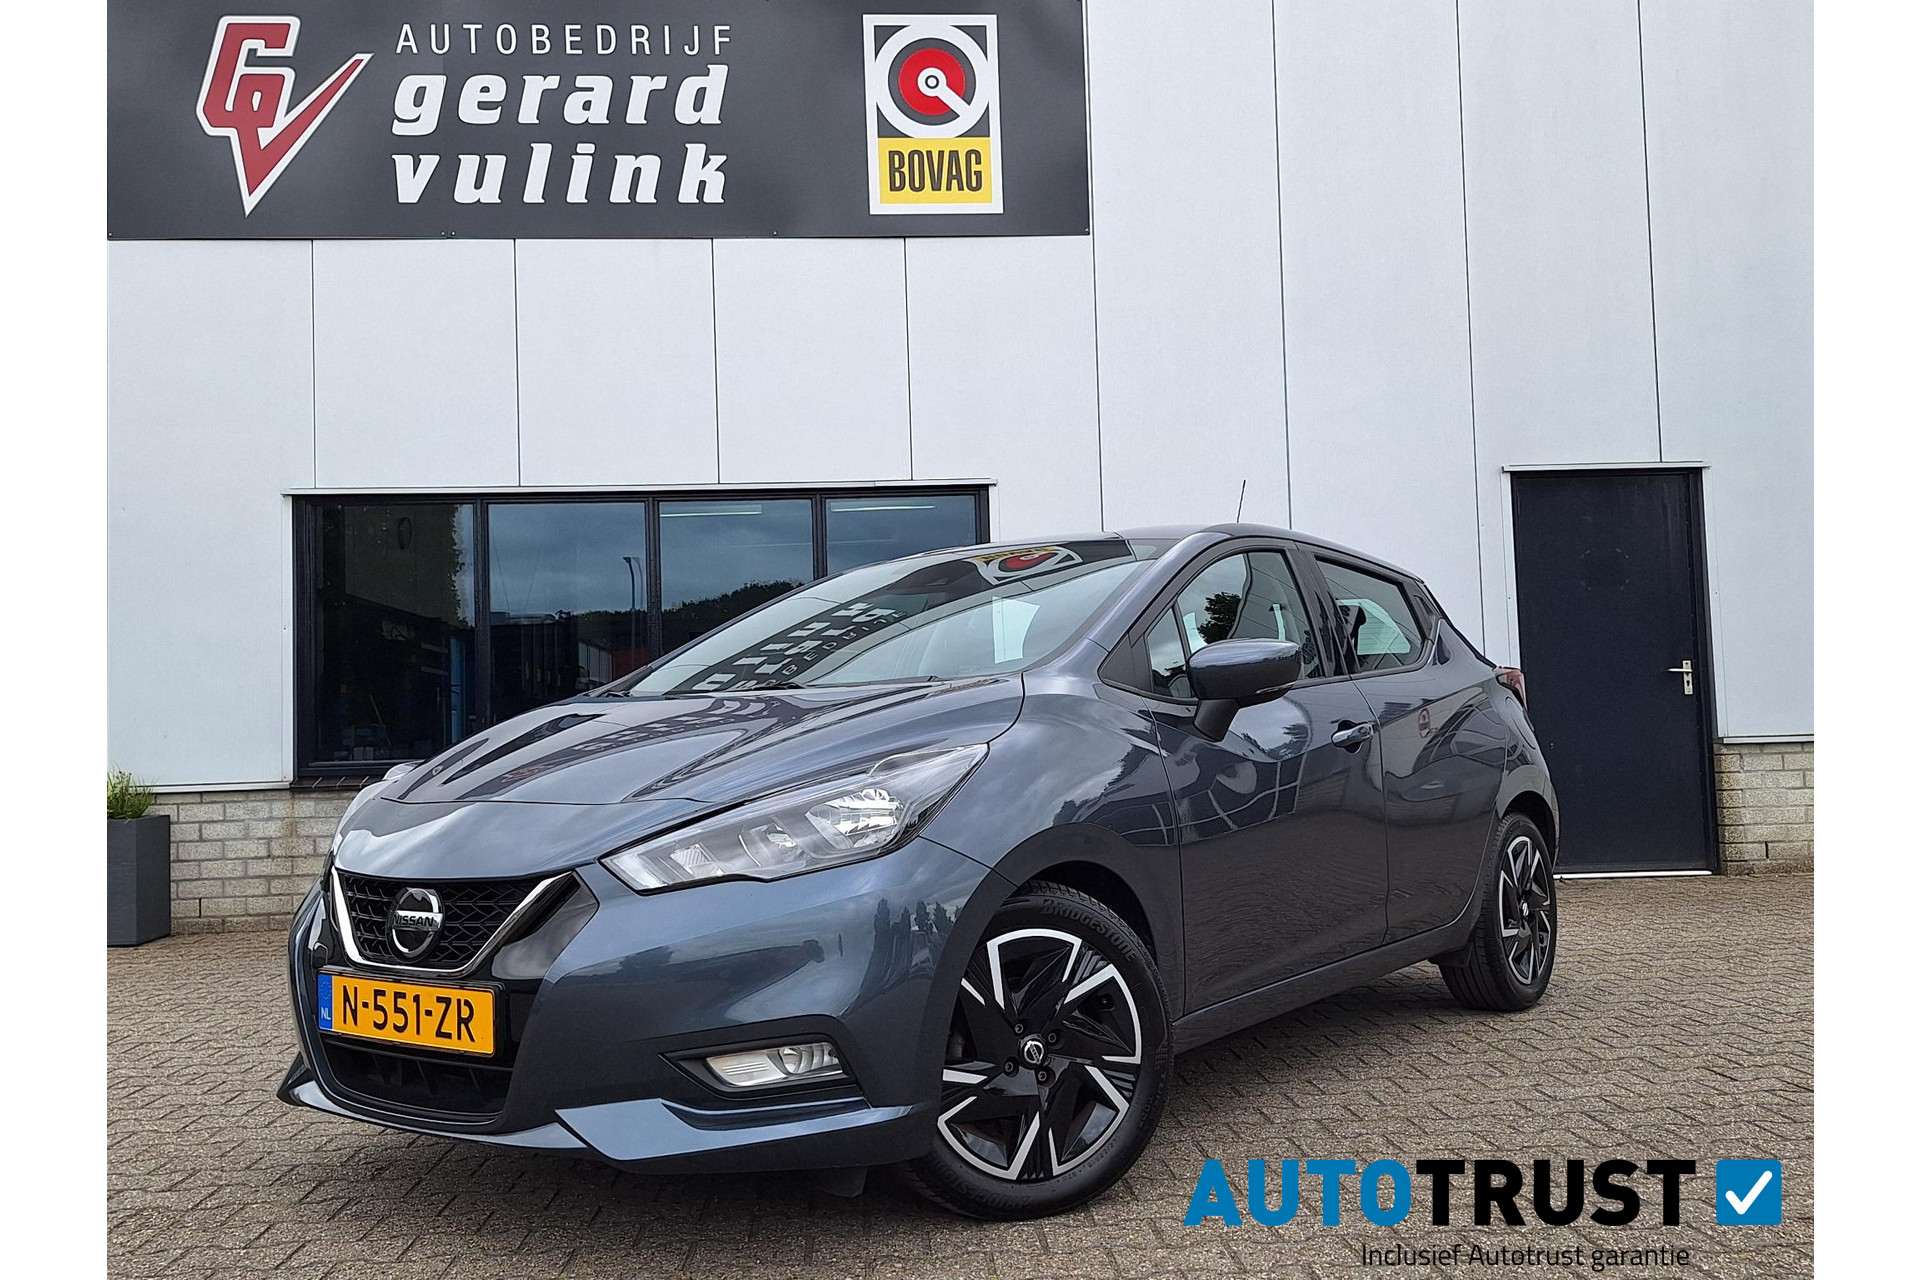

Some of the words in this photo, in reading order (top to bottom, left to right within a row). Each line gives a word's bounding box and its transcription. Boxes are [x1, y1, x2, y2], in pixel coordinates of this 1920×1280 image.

[395, 23, 732, 56] AUTOBEDRIJF
[391, 64, 729, 136] gerard
[391, 142, 728, 204] vulink
[887, 148, 984, 194] BOVAG
[393, 914, 435, 928] NISSAN
[1039, 898, 1137, 962] BRIDGESTONE
[320, 1006, 332, 1021] NL
[341, 984, 476, 1042] N-551-ZR
